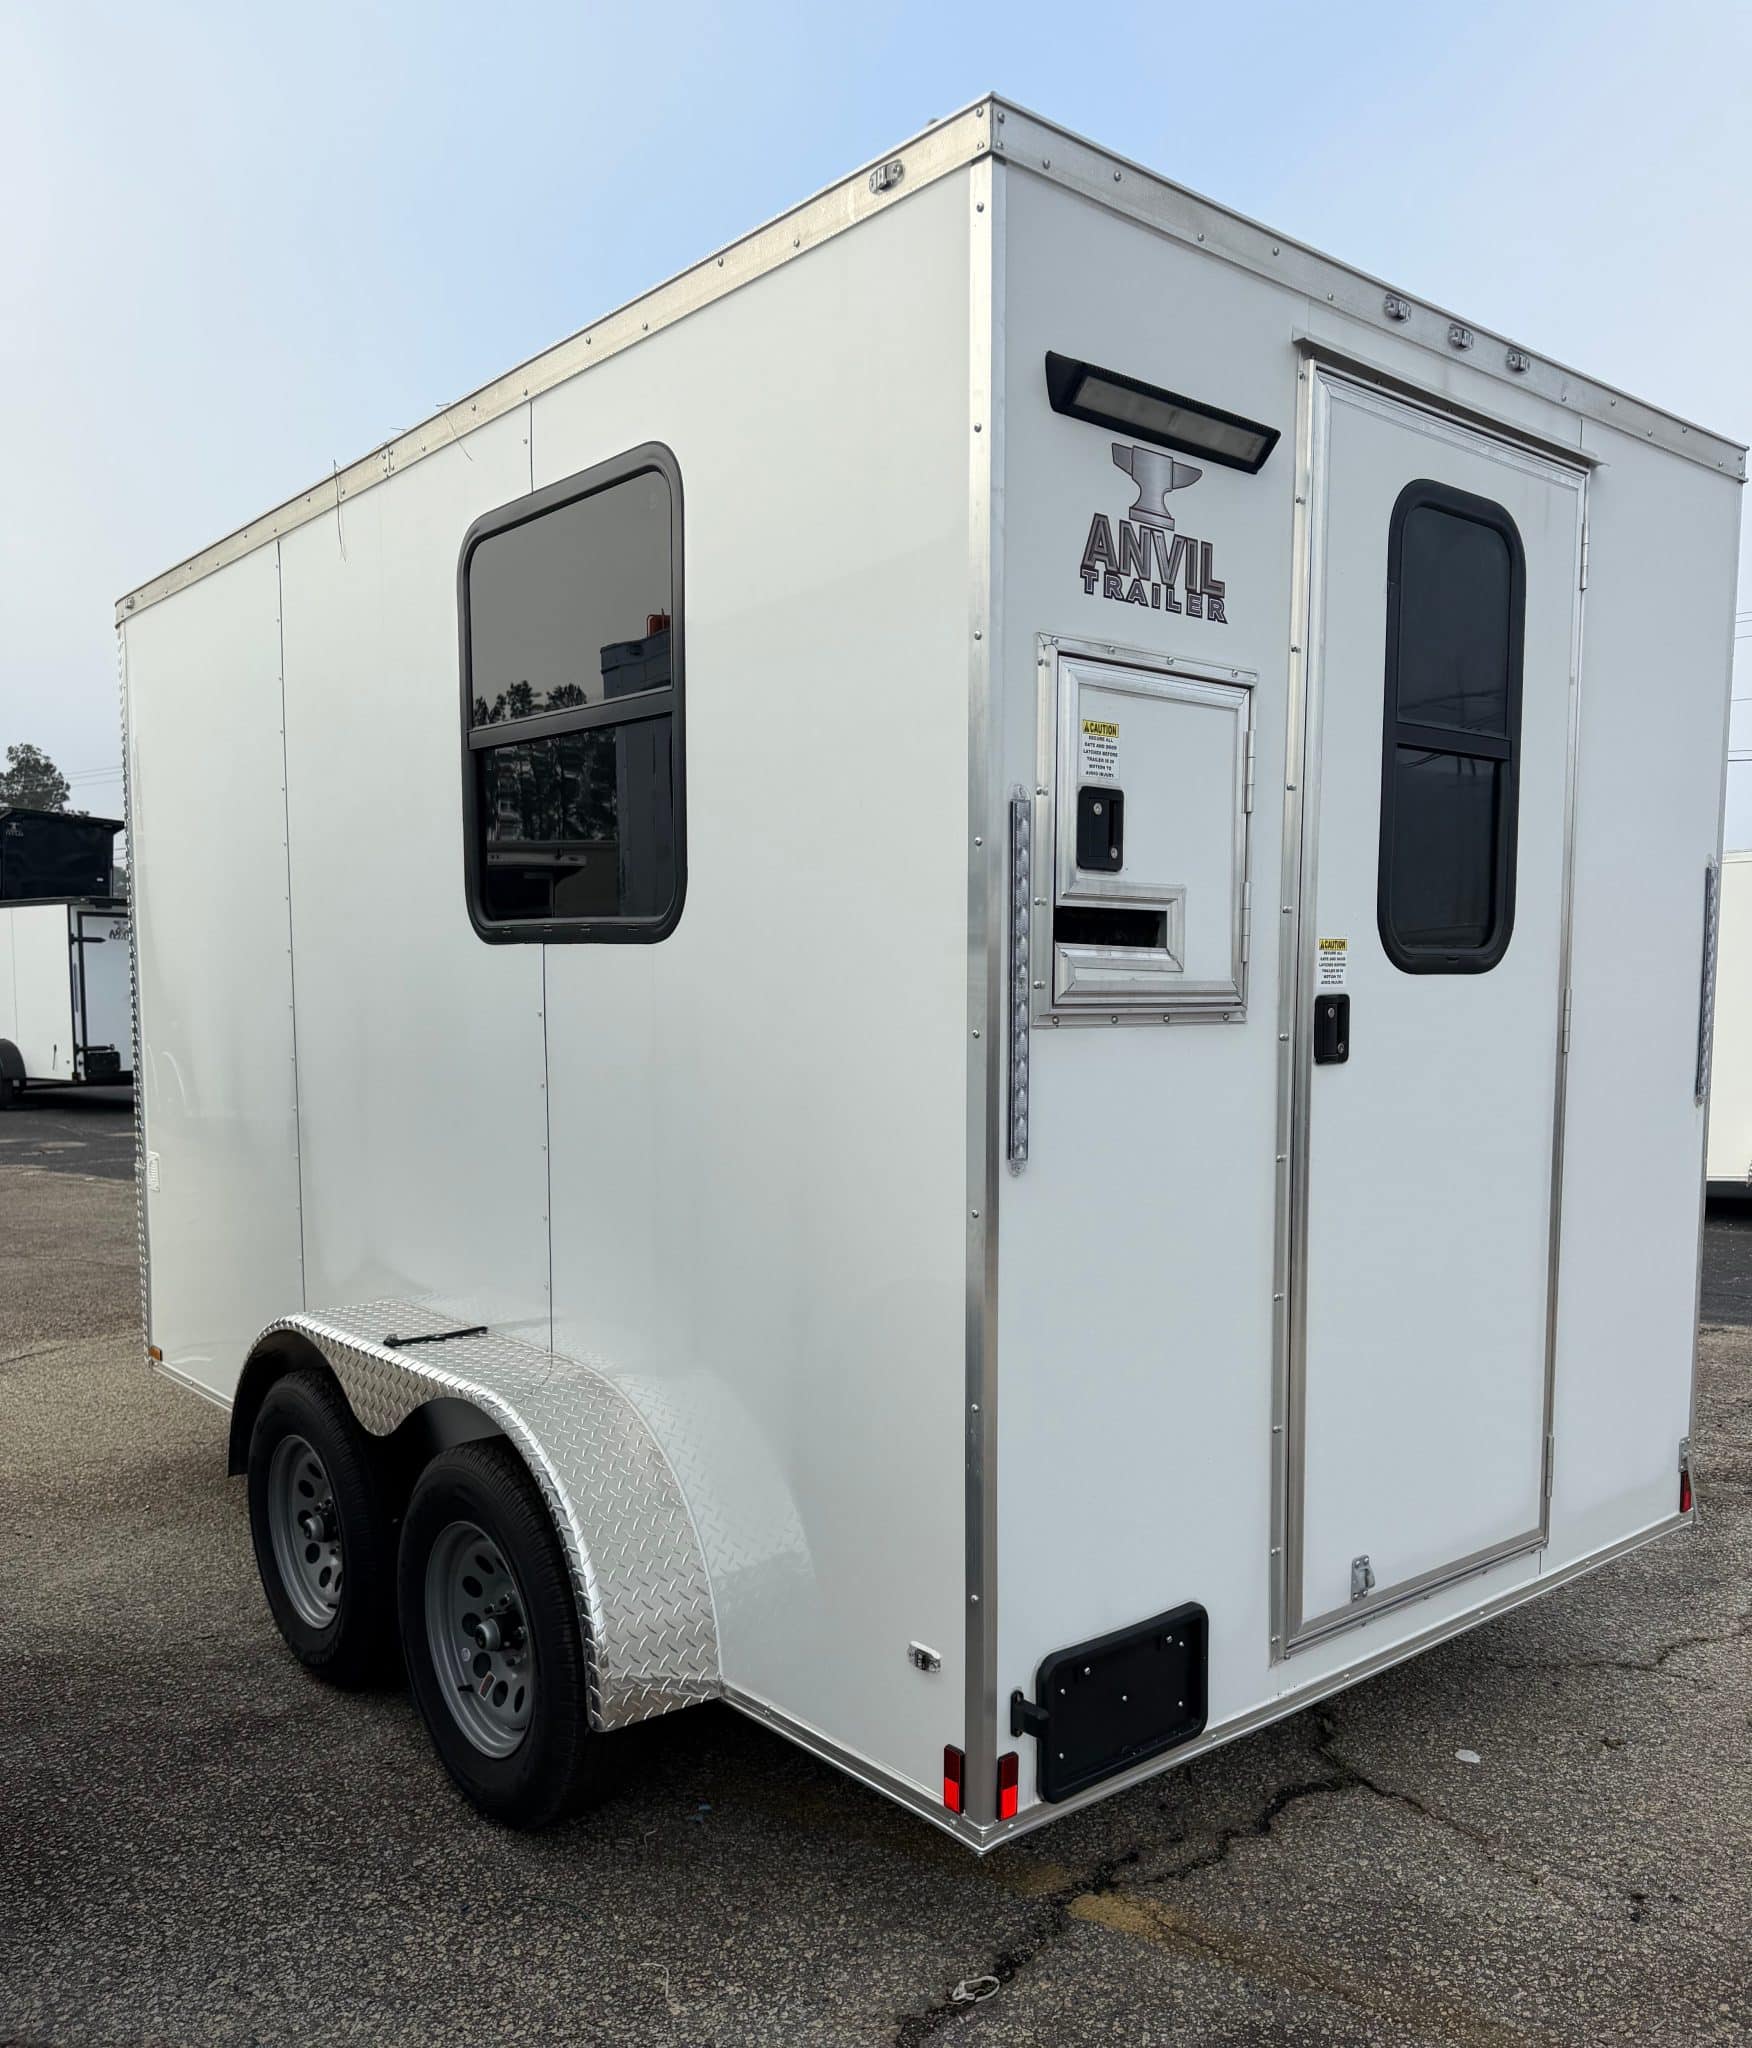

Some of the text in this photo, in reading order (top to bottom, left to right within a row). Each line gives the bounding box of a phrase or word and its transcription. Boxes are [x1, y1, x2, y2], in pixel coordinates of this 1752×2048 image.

[1081, 513, 1225, 599] ANVIL
[1080, 569, 1228, 624] TRAILER
[1090, 722, 1117, 736] CAUTION
[1325, 940, 1345, 949] CAUTION
